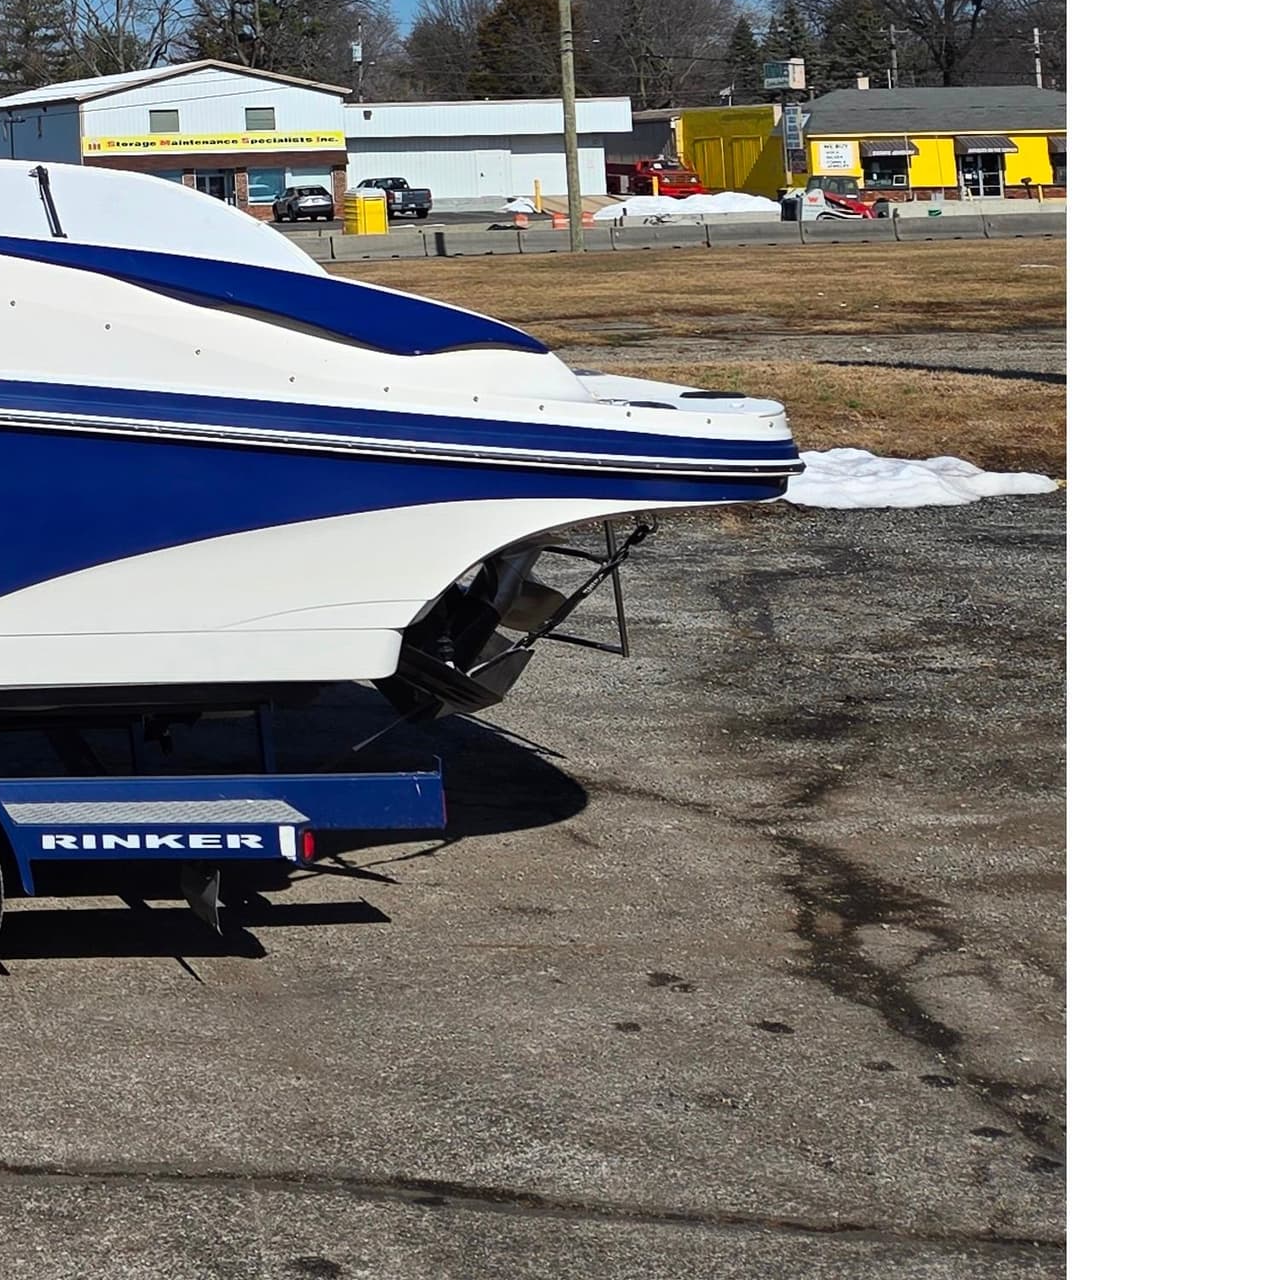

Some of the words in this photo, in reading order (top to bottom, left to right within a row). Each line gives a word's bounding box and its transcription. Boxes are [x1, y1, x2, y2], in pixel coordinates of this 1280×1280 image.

[107, 140, 157, 148] Storage
[159, 138, 239, 146] Maintenance
[241, 137, 313, 145] Specialists
[41, 833, 265, 850] RINKER
